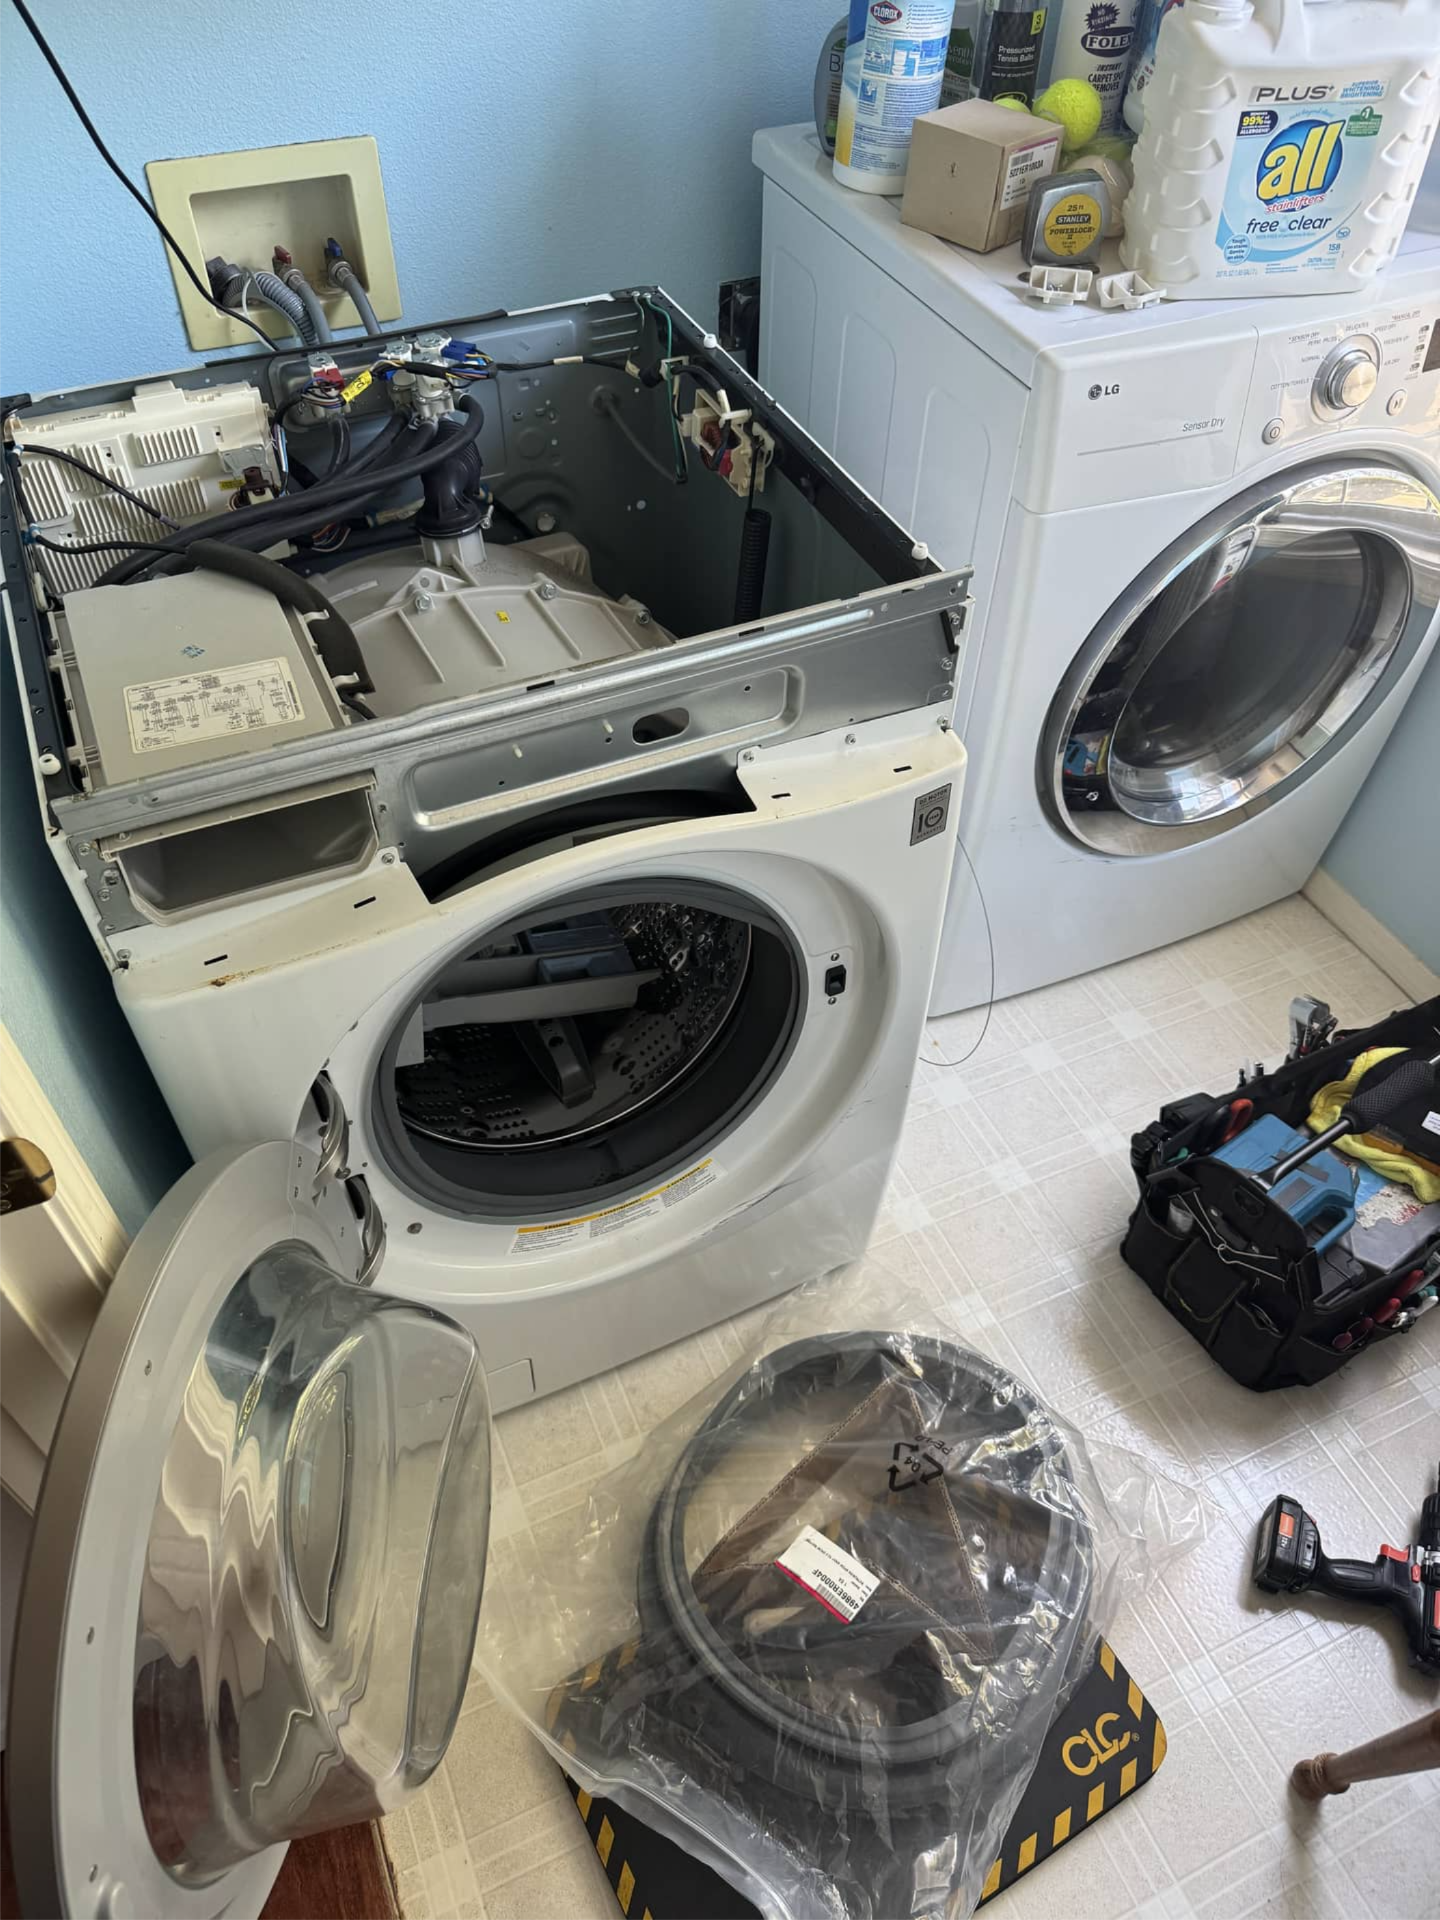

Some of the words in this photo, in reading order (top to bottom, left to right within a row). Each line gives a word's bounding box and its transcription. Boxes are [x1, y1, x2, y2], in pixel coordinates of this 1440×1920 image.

[873, 6, 899, 20] CLOROX
[1036, 14, 1042, 25] 3
[997, 54, 1019, 63] Tennis
[1088, 73, 1112, 84] CARPET
[1242, 115, 1264, 127] 99%
[1257, 119, 1346, 201] all
[1067, 204, 1078, 212] 25
[1266, 194, 1326, 214] stainlifters
[1057, 215, 1090, 224] STANLEY
[1246, 218, 1280, 234] free
[1287, 215, 1333, 231] clear
[1104, 384, 1120, 396] LG
[1182, 419, 1209, 432] Sensor
[1210, 417, 1226, 428] Dry
